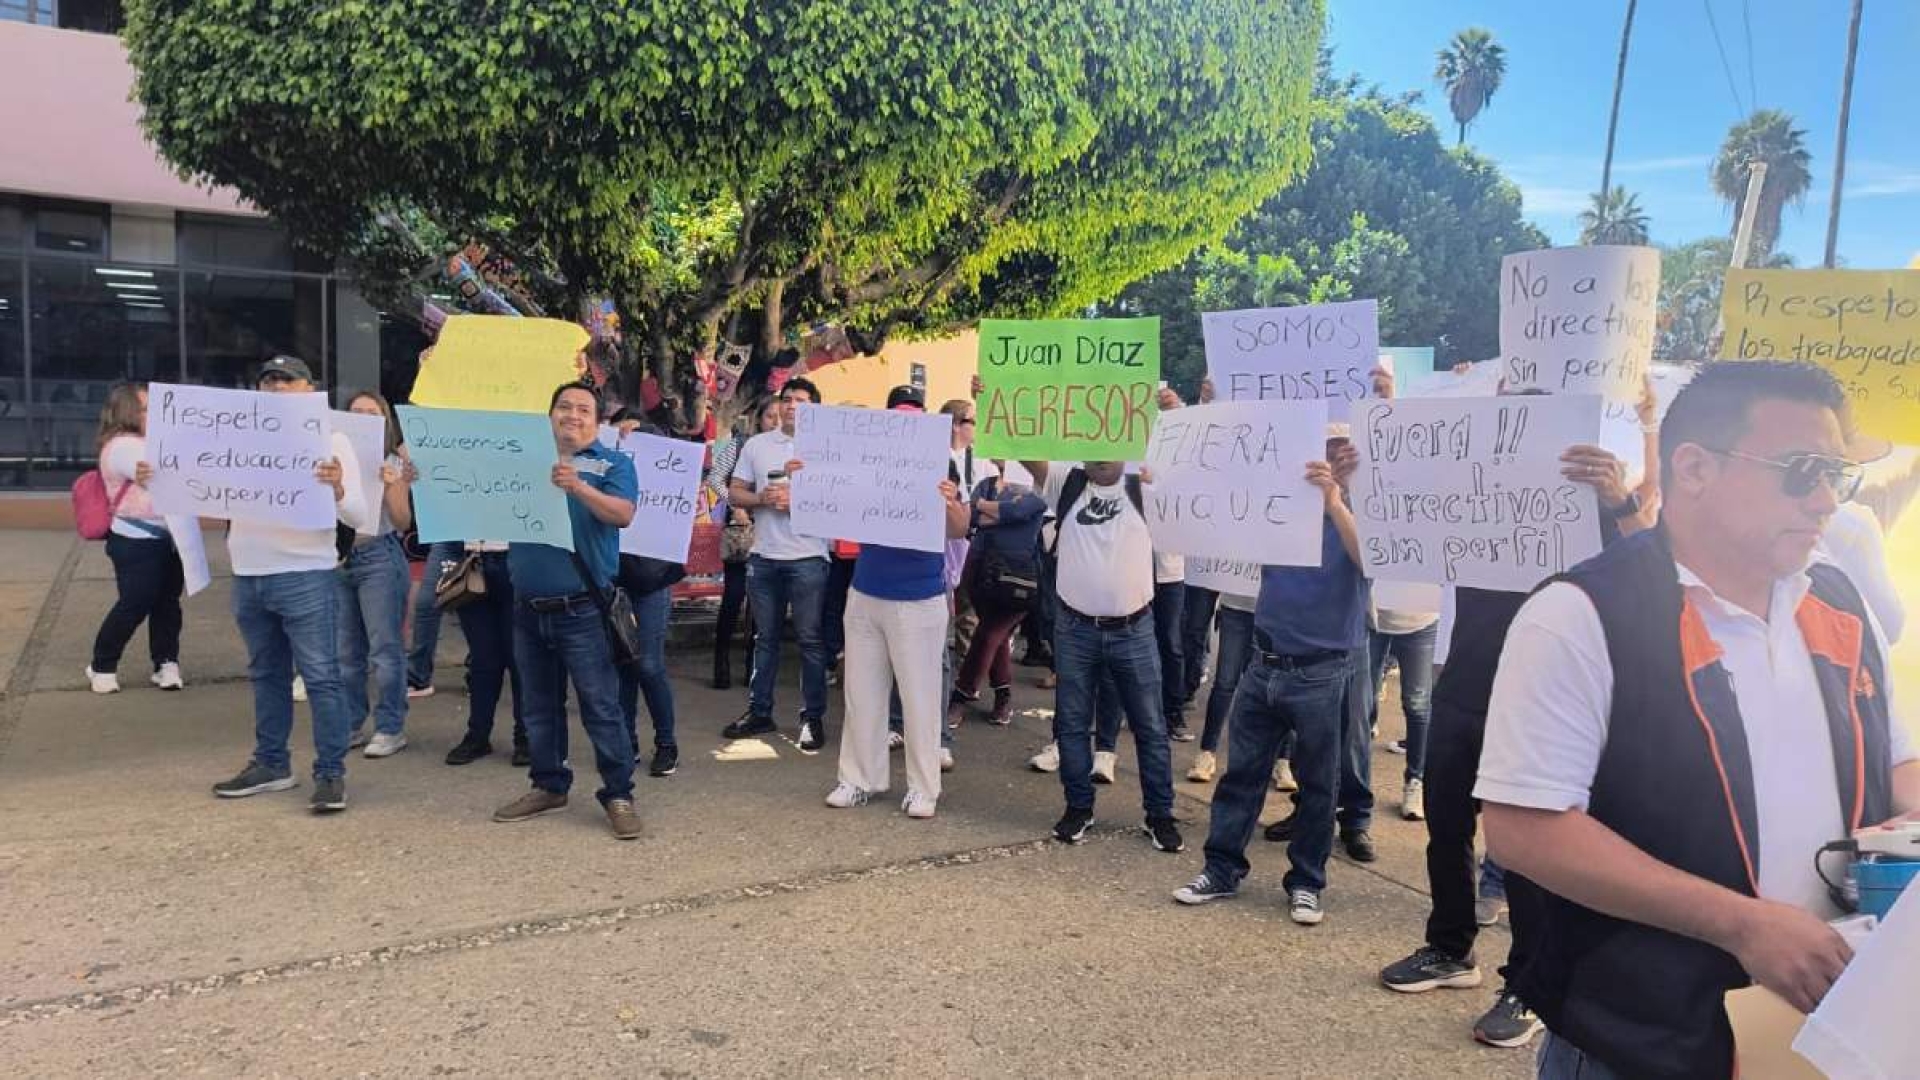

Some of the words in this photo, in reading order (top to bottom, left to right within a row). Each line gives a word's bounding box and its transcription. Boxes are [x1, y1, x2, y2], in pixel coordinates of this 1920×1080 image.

[1511, 259, 1548, 306] No
[1573, 277, 1596, 294] a
[1745, 281, 1918, 334] Respeto
[989, 335, 1061, 366] Juan
[1076, 335, 1145, 367] Díaz
[1231, 313, 1361, 353] SOMOS
[1738, 327, 1775, 359] los
[1561, 350, 1640, 390] perfil
[162, 390, 282, 435] Respeto
[303, 417, 321, 435] a
[984, 382, 1153, 448] AGRESOR
[158, 440, 179, 471] la
[655, 449, 688, 473] de
[1156, 422, 1281, 472] FUERA
[1154, 489, 1293, 526] VIQUE
[1365, 462, 1581, 524] directivos
[1367, 533, 1423, 566] sin
[1442, 522, 1564, 582] perfil
